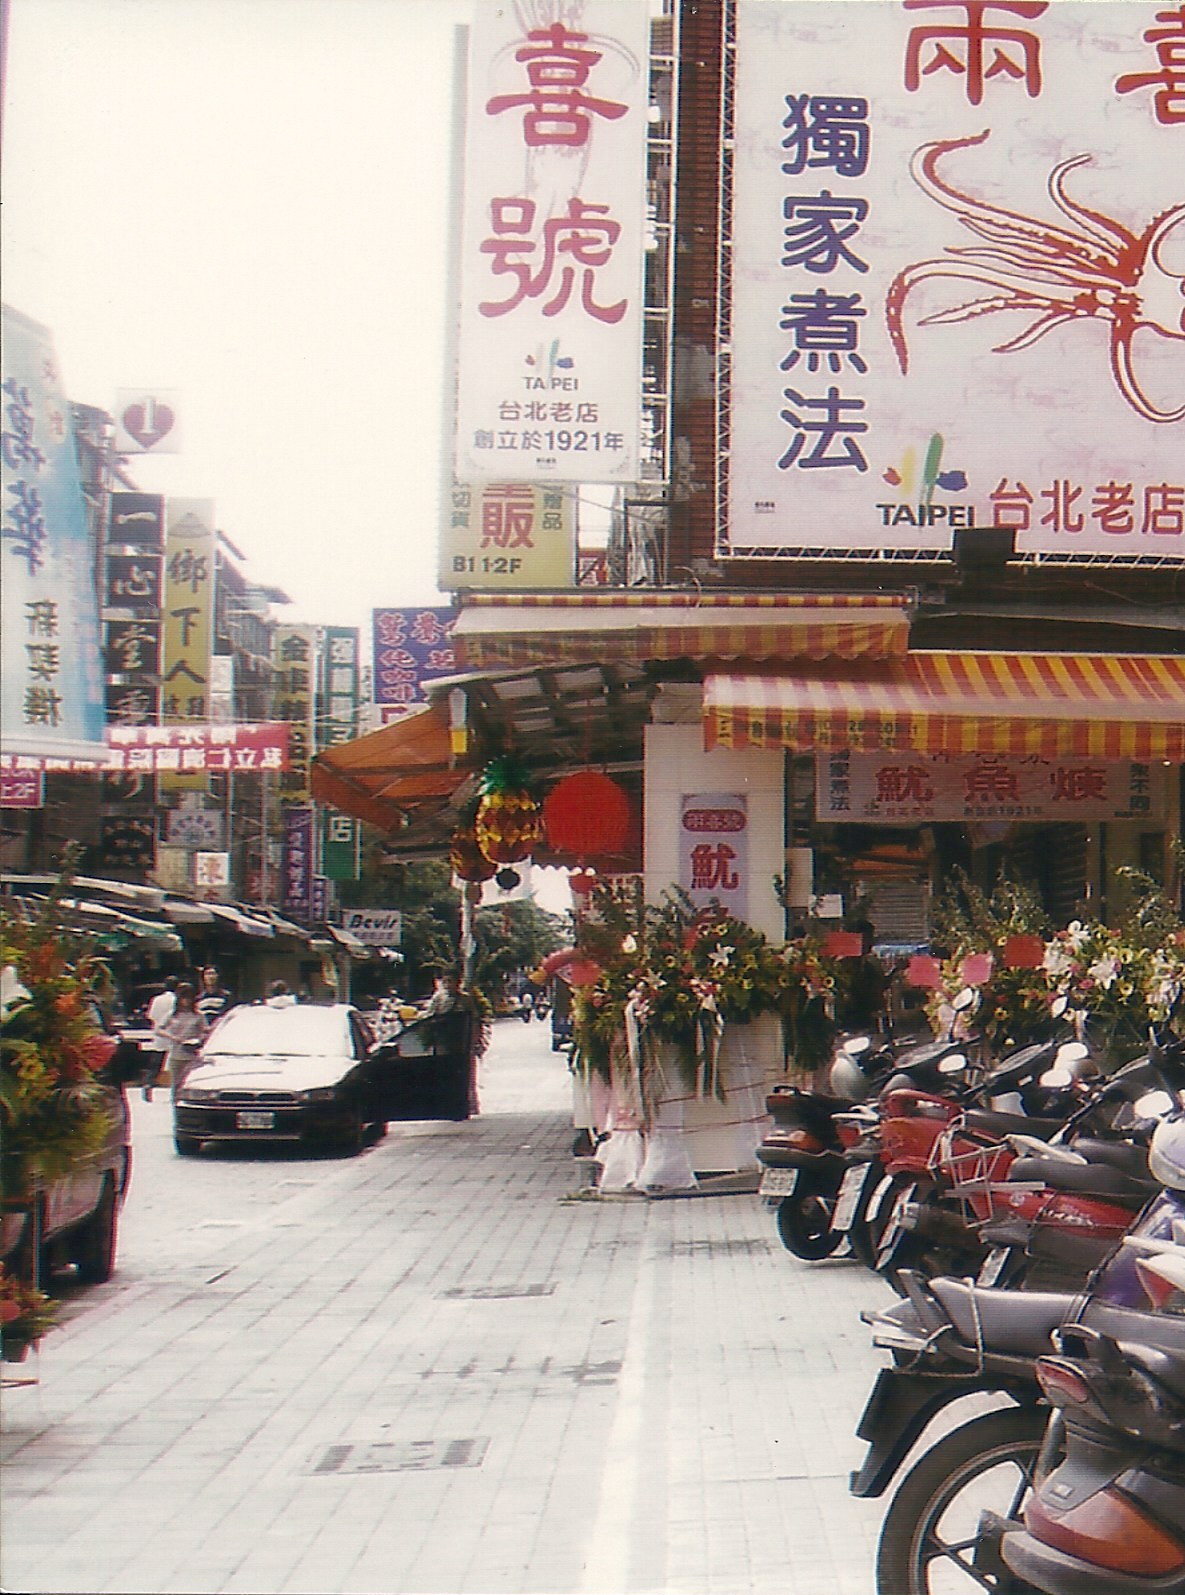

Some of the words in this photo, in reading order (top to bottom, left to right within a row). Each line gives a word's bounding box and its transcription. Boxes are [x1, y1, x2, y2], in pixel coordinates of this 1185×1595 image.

[478, 22, 629, 325] 喜號
[778, 94, 869, 473] 獨家煮法
[498, 401, 598, 424] 台北老店
[474, 430, 624, 453] 創立於1921年
[876, 503, 975, 527] TAIPEI
[989, 477, 1185, 536] 台北老店
